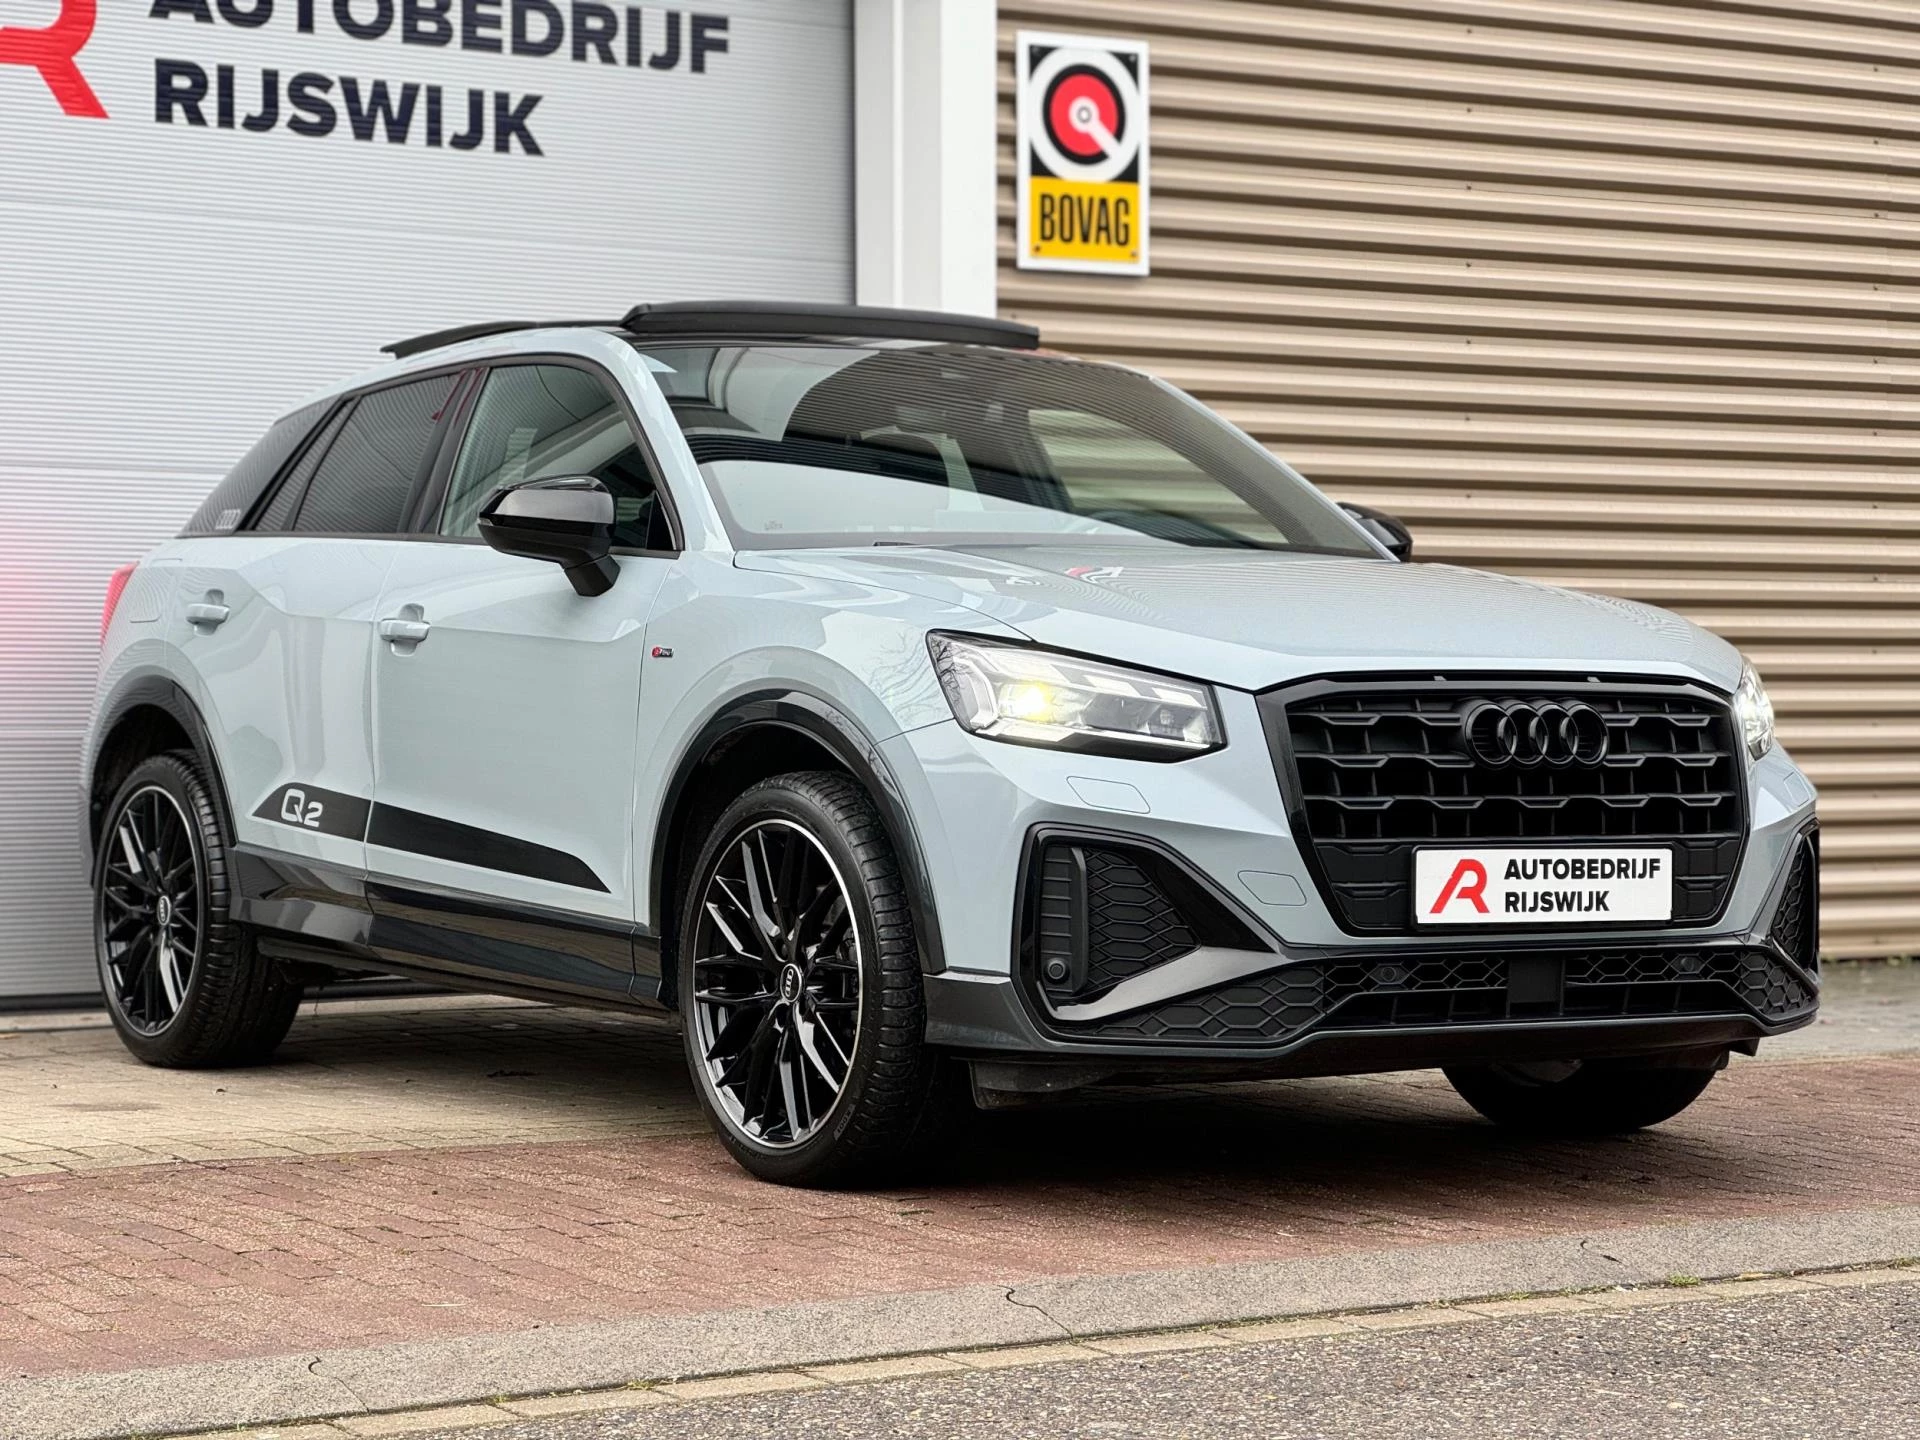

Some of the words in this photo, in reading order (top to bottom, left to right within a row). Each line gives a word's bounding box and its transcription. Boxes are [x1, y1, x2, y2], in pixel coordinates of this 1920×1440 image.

[154, 58, 544, 157] RIJSWIJK
[1039, 193, 1130, 247] BOVAG
[281, 788, 324, 828] Q2
[1503, 858, 1661, 880] AUTOBEDRIJF
[1504, 890, 1610, 913] RIJSWIJK
